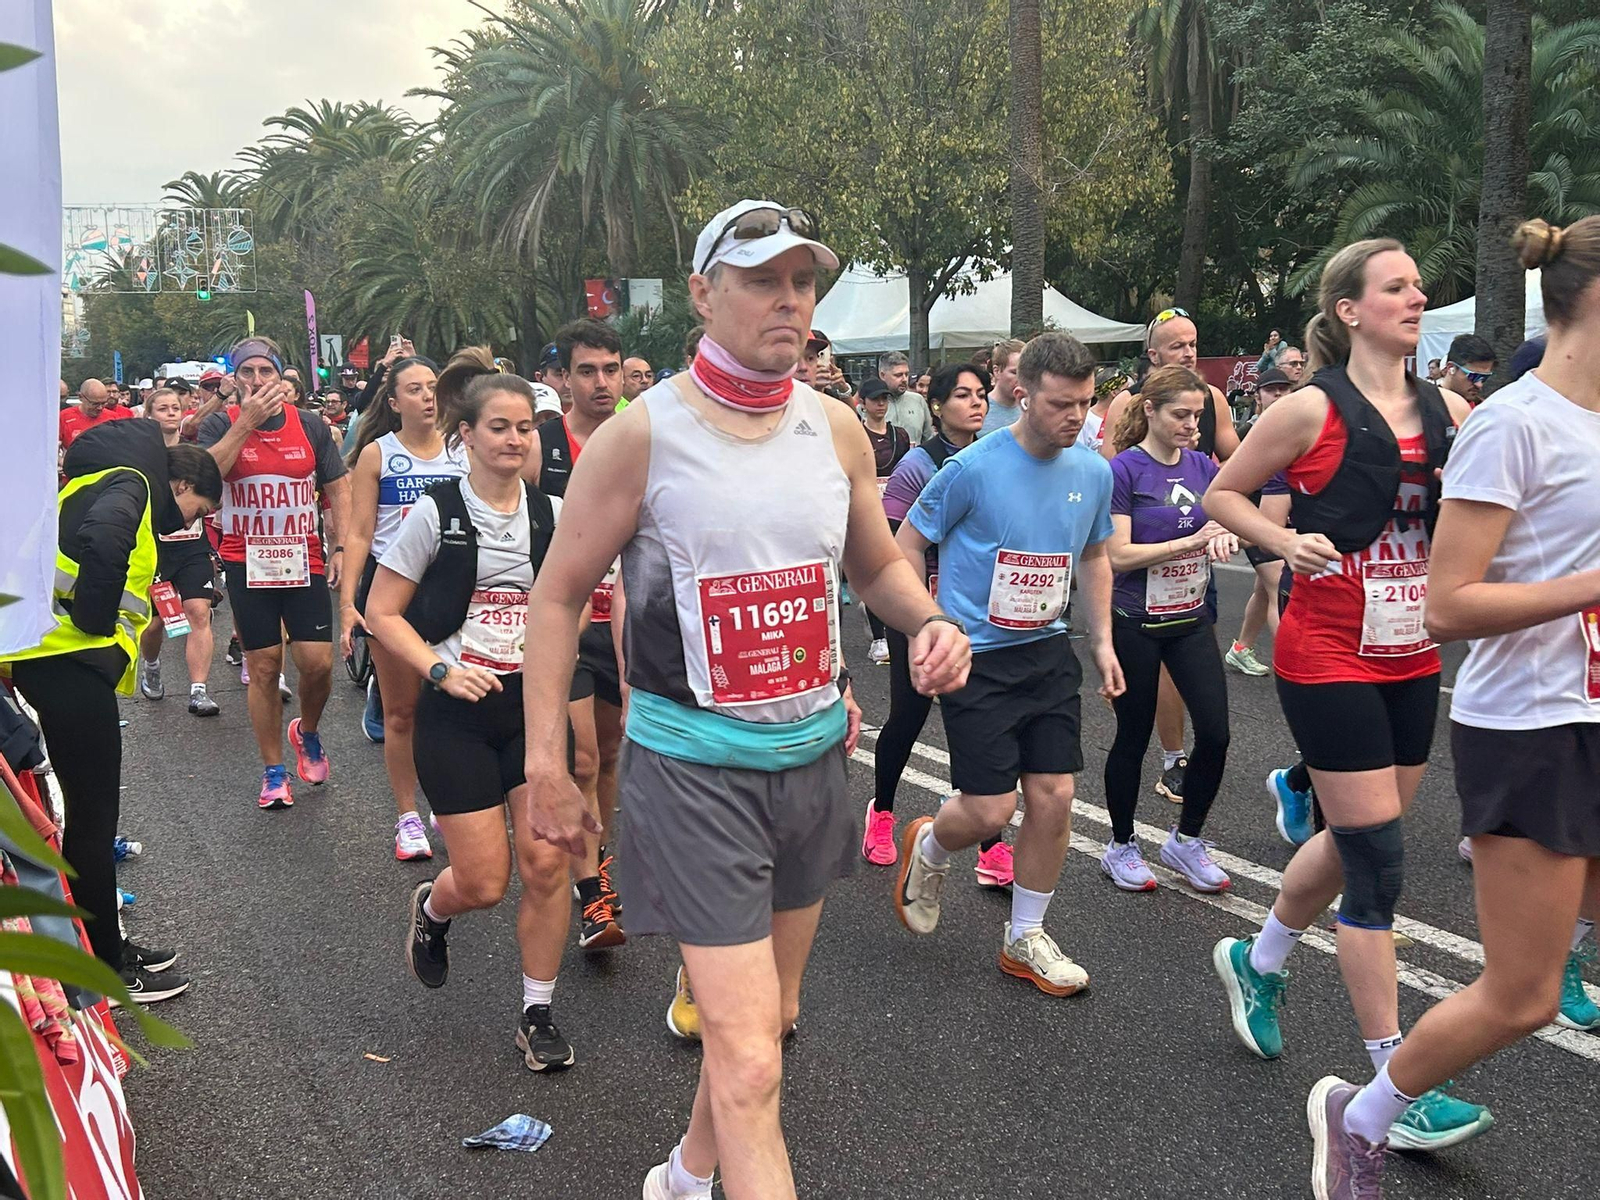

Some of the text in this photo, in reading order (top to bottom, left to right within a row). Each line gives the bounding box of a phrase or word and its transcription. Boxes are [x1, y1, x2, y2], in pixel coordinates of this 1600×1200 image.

[794, 429, 818, 437] adidas
[258, 549, 294, 559] 23086
[1020, 555, 1064, 567] GENERALI
[1162, 562, 1198, 578] 25232
[737, 567, 817, 594] GENERALI
[1009, 572, 1054, 587] 24292
[729, 597, 809, 631] 11692
[762, 629, 785, 641] MIKA
[748, 647, 780, 657] GENERALI
[750, 661, 782, 675] MÁLAGA
